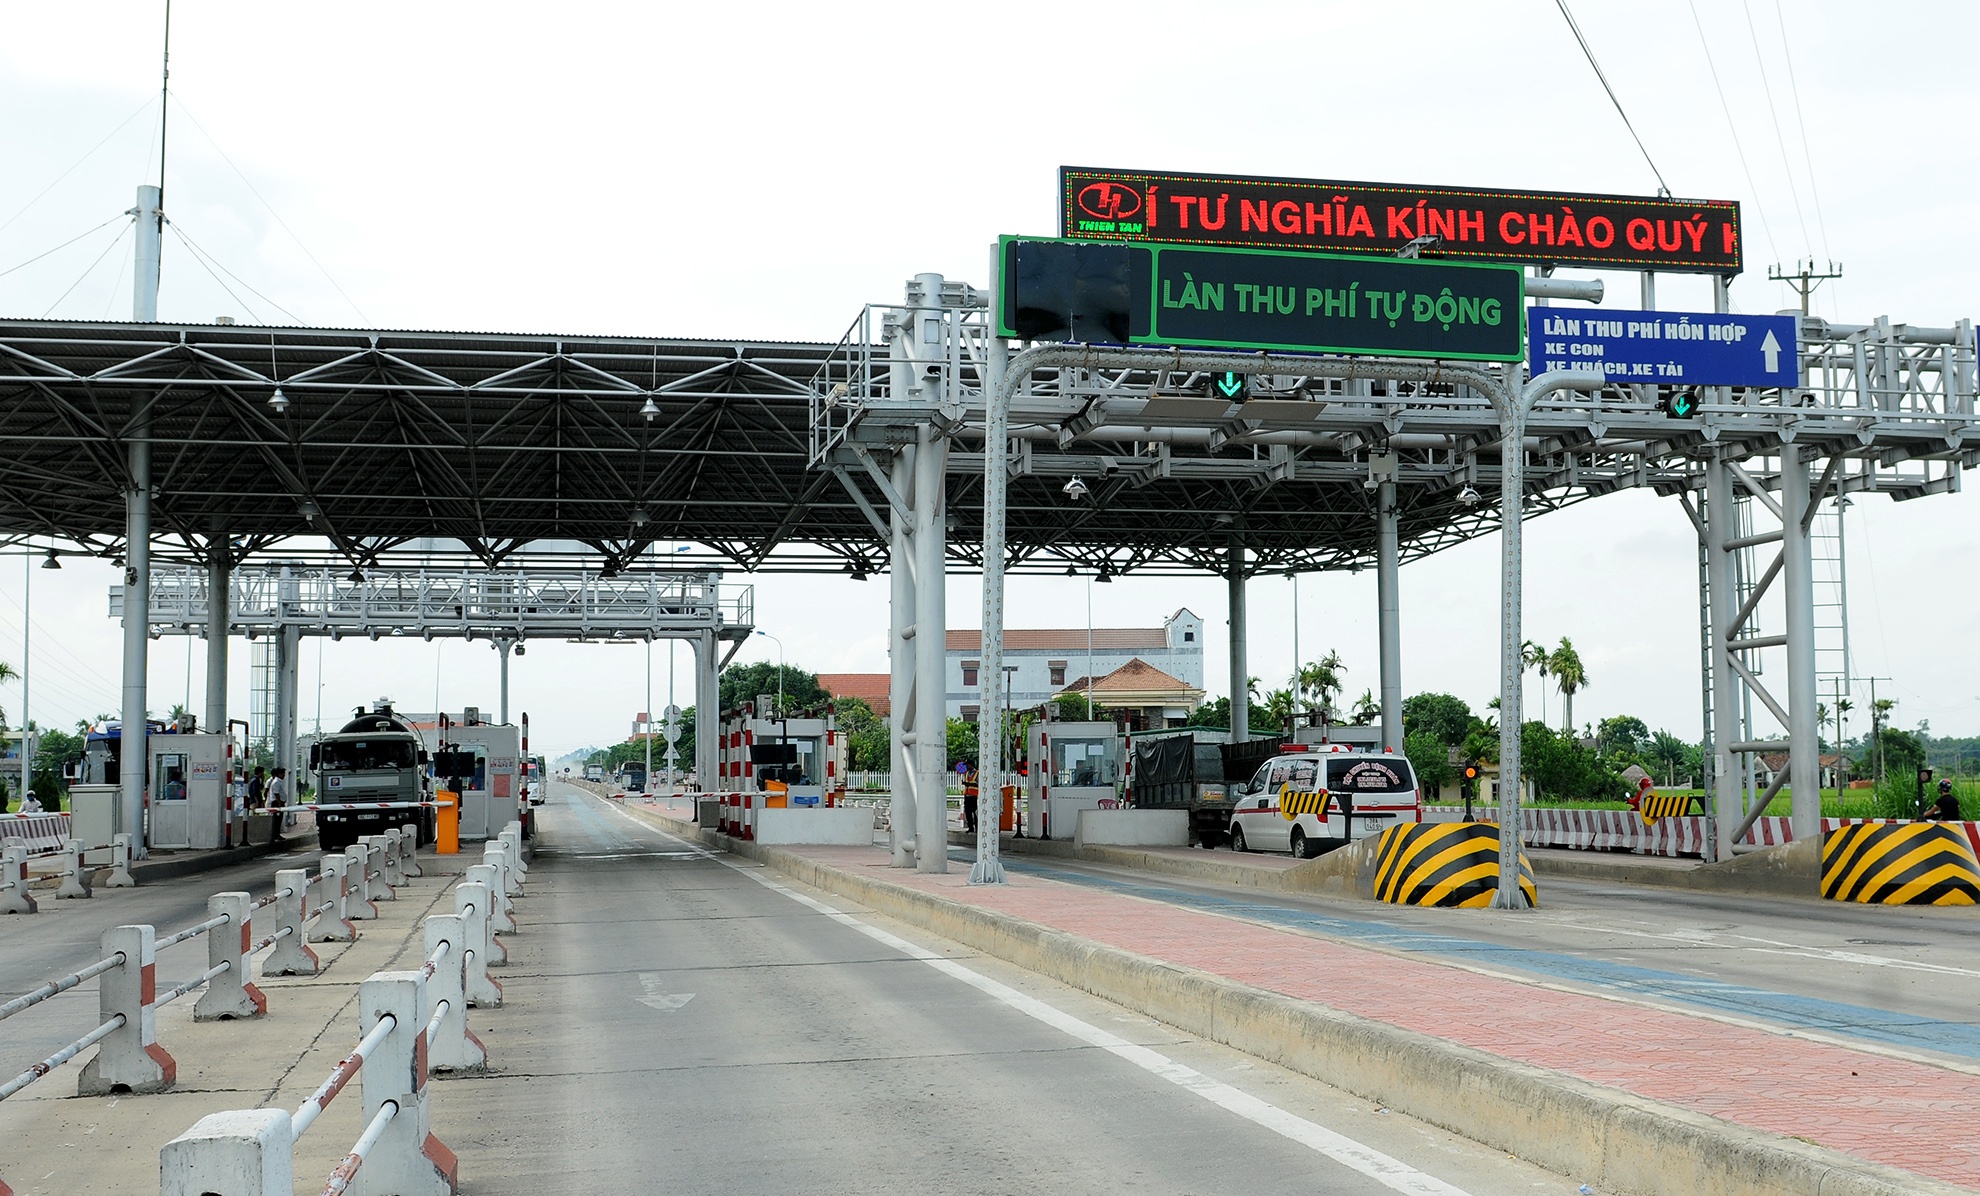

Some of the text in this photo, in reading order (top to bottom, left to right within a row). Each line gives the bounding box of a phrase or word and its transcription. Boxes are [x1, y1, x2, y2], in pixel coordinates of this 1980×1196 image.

[1078, 220, 1143, 233] THIEN TAN
[1171, 194, 1229, 231] TƯ
[1241, 195, 1376, 238] NGHĨA
[1388, 200, 1485, 242] KÍNH
[1498, 206, 1615, 249] CHÀO
[1625, 213, 1708, 253] QUÝ
[1163, 272, 1502, 332] LÀN THU PHÍ TỰ ĐỘNG
[1543, 315, 1748, 345] LÀN THU PHÍ HỖN HỢP
[1545, 343, 1604, 356] XE CON
[1545, 360, 1567, 372] XE
[1656, 361, 1683, 377] TẢI
